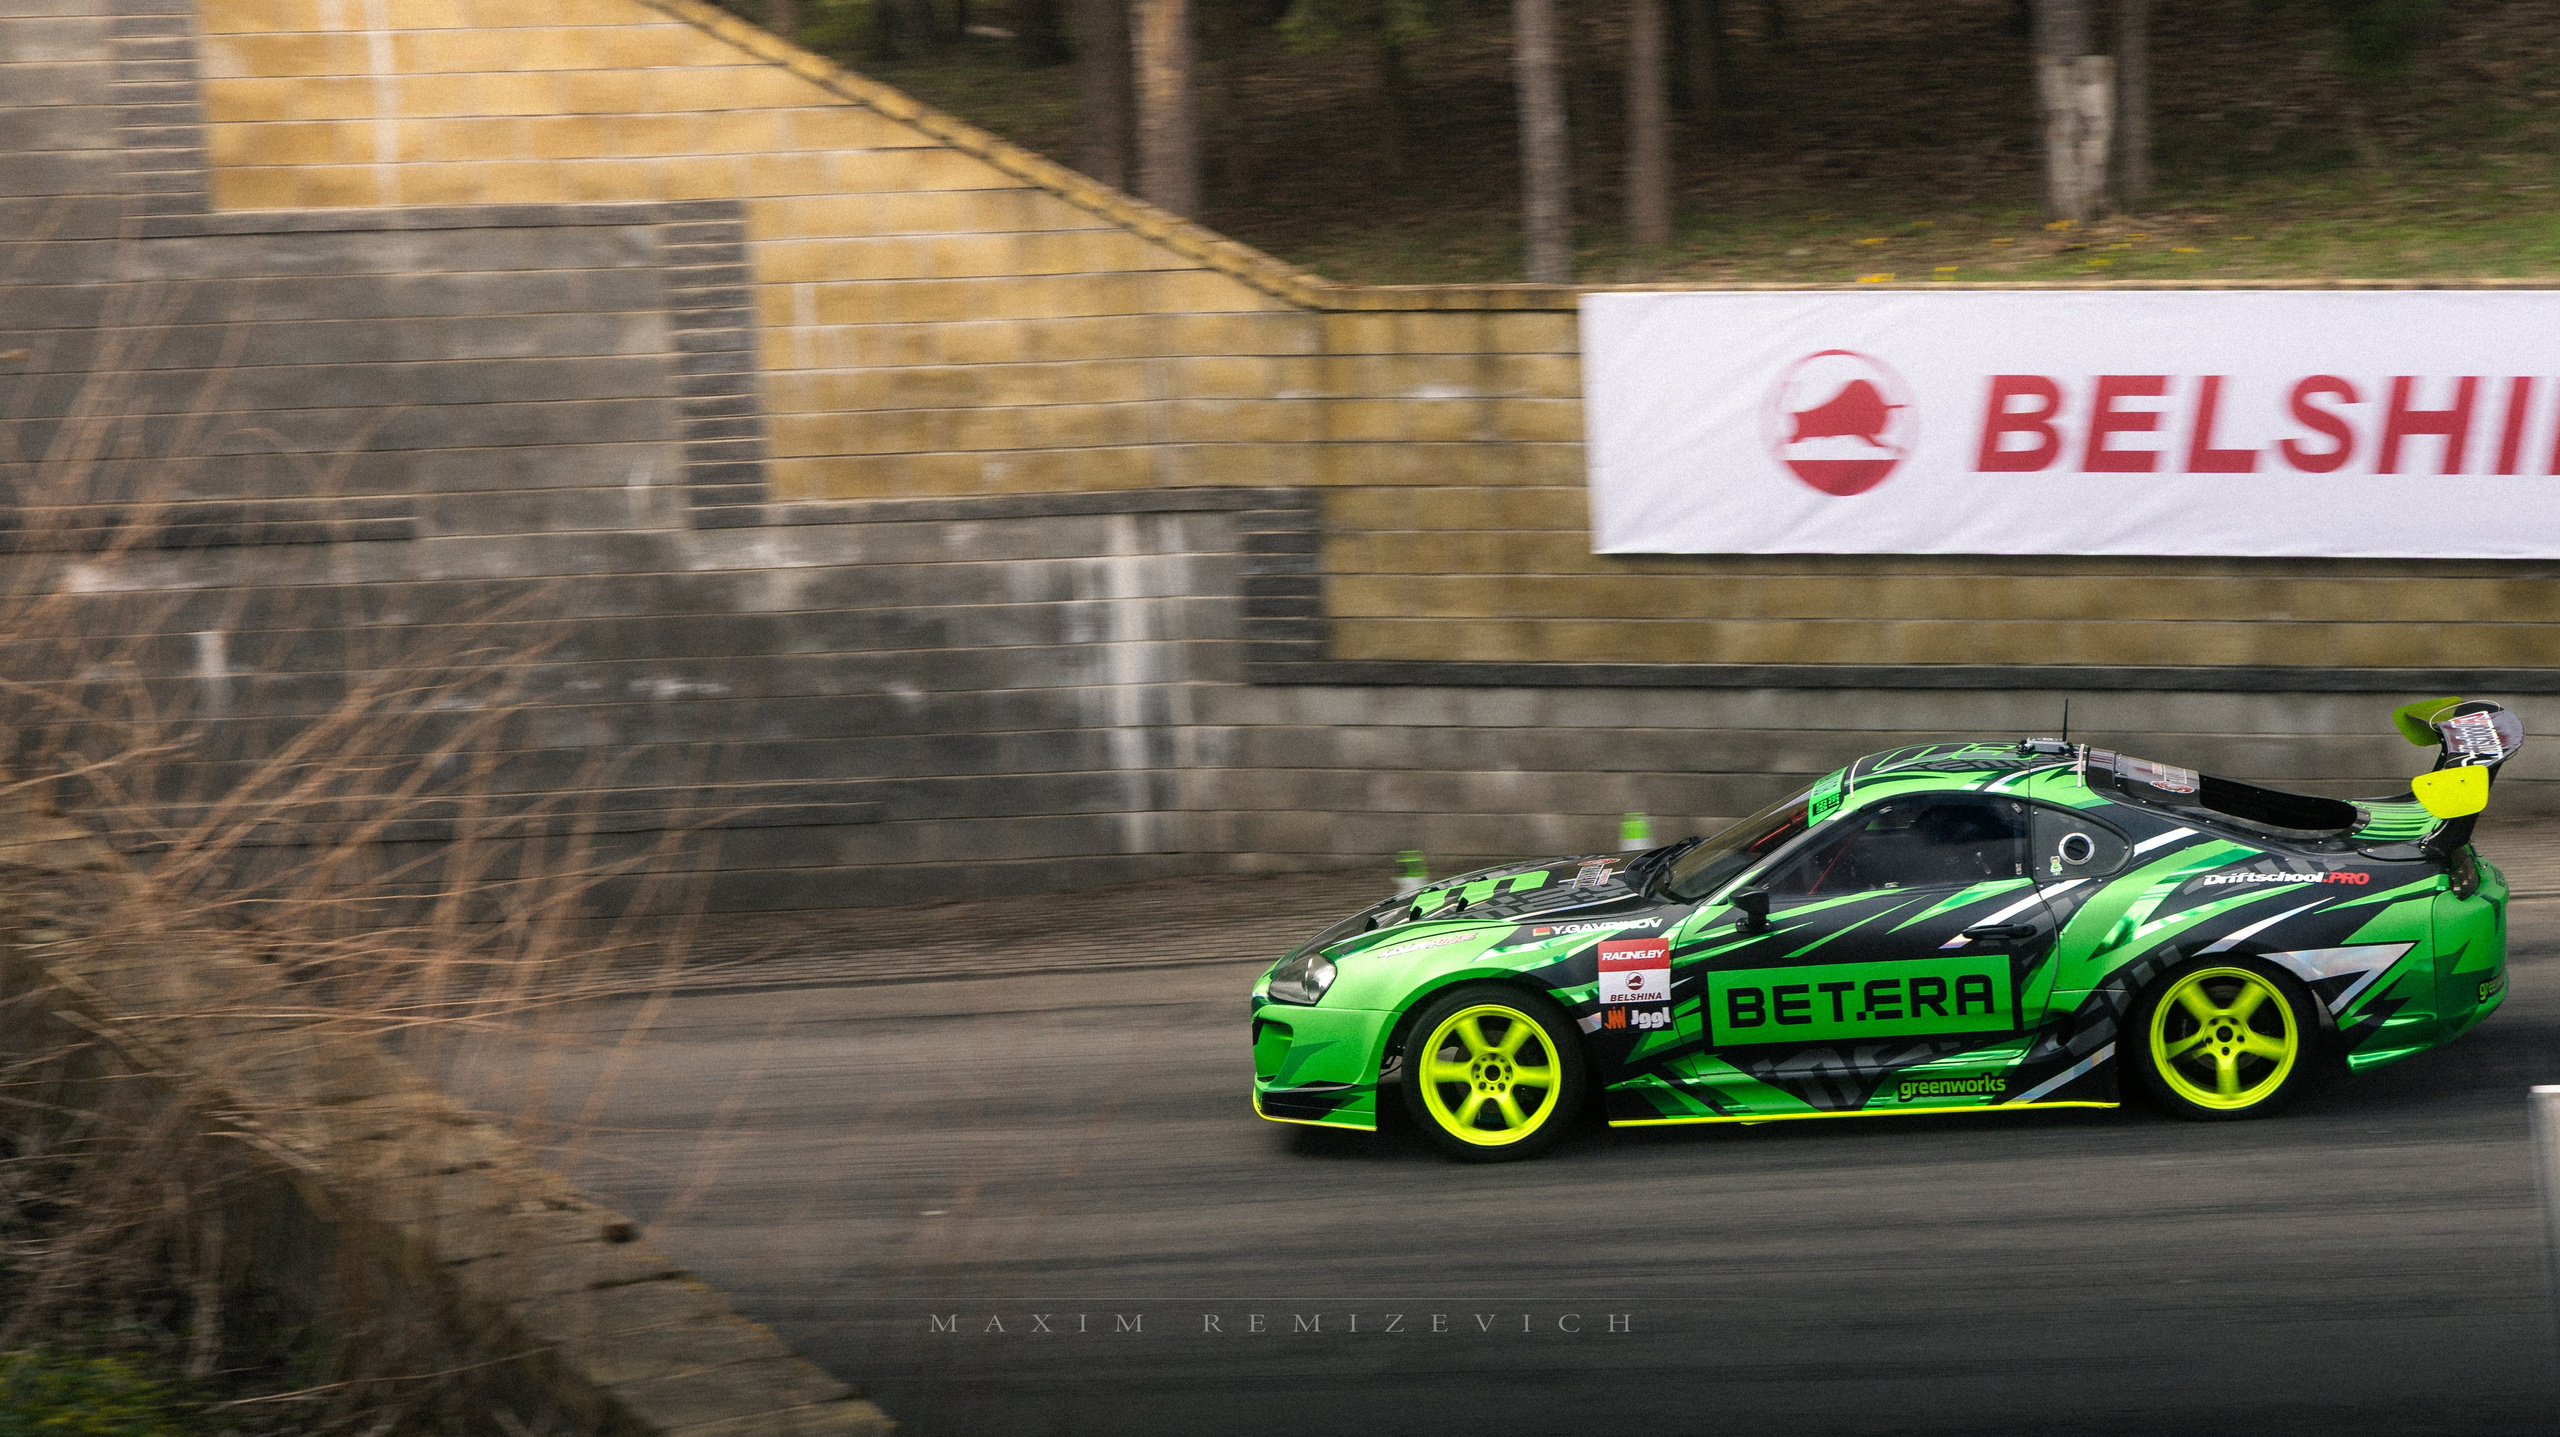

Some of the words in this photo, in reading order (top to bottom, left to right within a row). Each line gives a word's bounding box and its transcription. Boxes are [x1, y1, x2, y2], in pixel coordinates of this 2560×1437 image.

[1972, 374, 2560, 476] BELSHI
[1602, 949, 1665, 961] RACING.BY
[1610, 992, 1662, 1002] BELSHINA
[1900, 1075, 2006, 1099] greenworks
